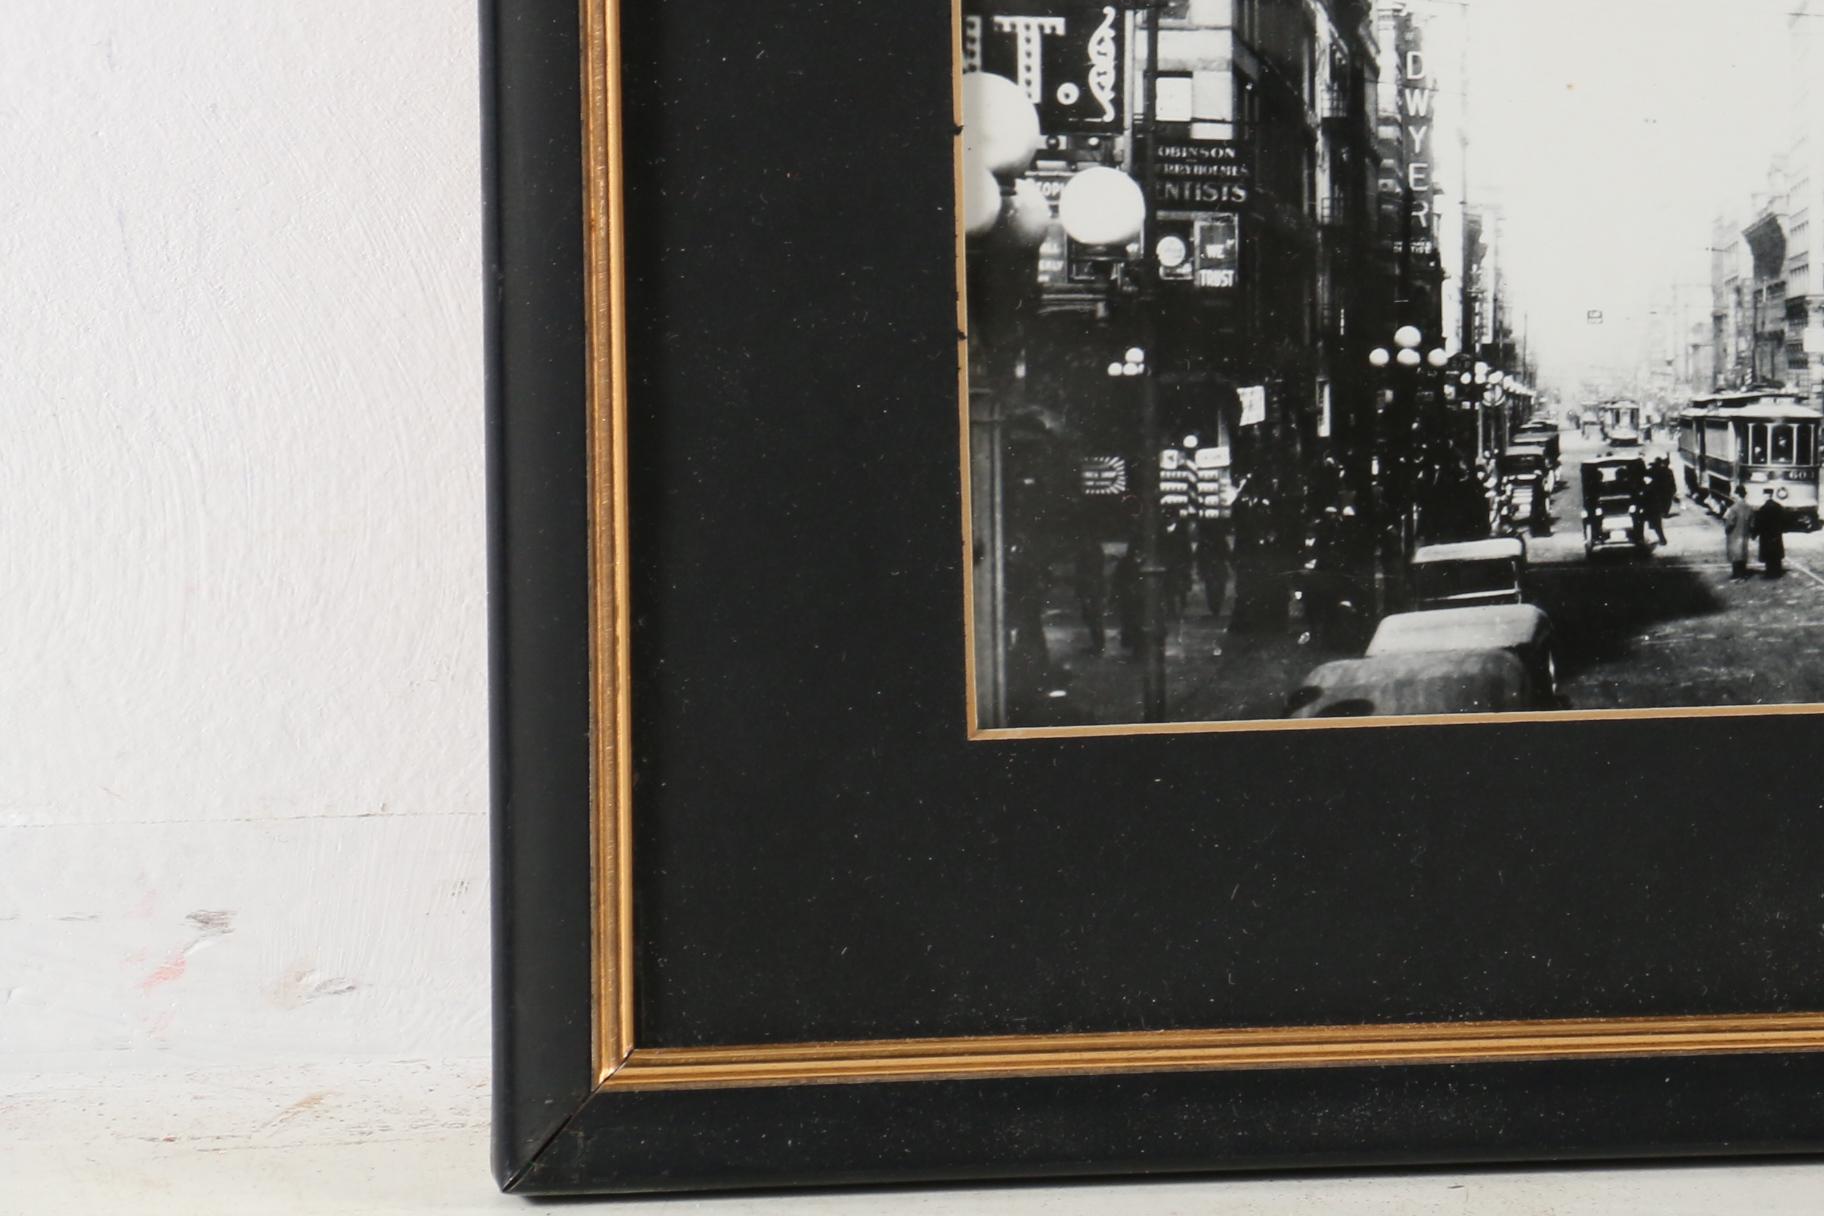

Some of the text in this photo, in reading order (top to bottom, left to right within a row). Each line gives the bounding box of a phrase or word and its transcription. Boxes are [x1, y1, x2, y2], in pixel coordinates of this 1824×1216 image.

[1405, 51, 1431, 228] DWYER
[1157, 146, 1236, 158] OBINSON
[1199, 269, 1235, 287] TRUST
